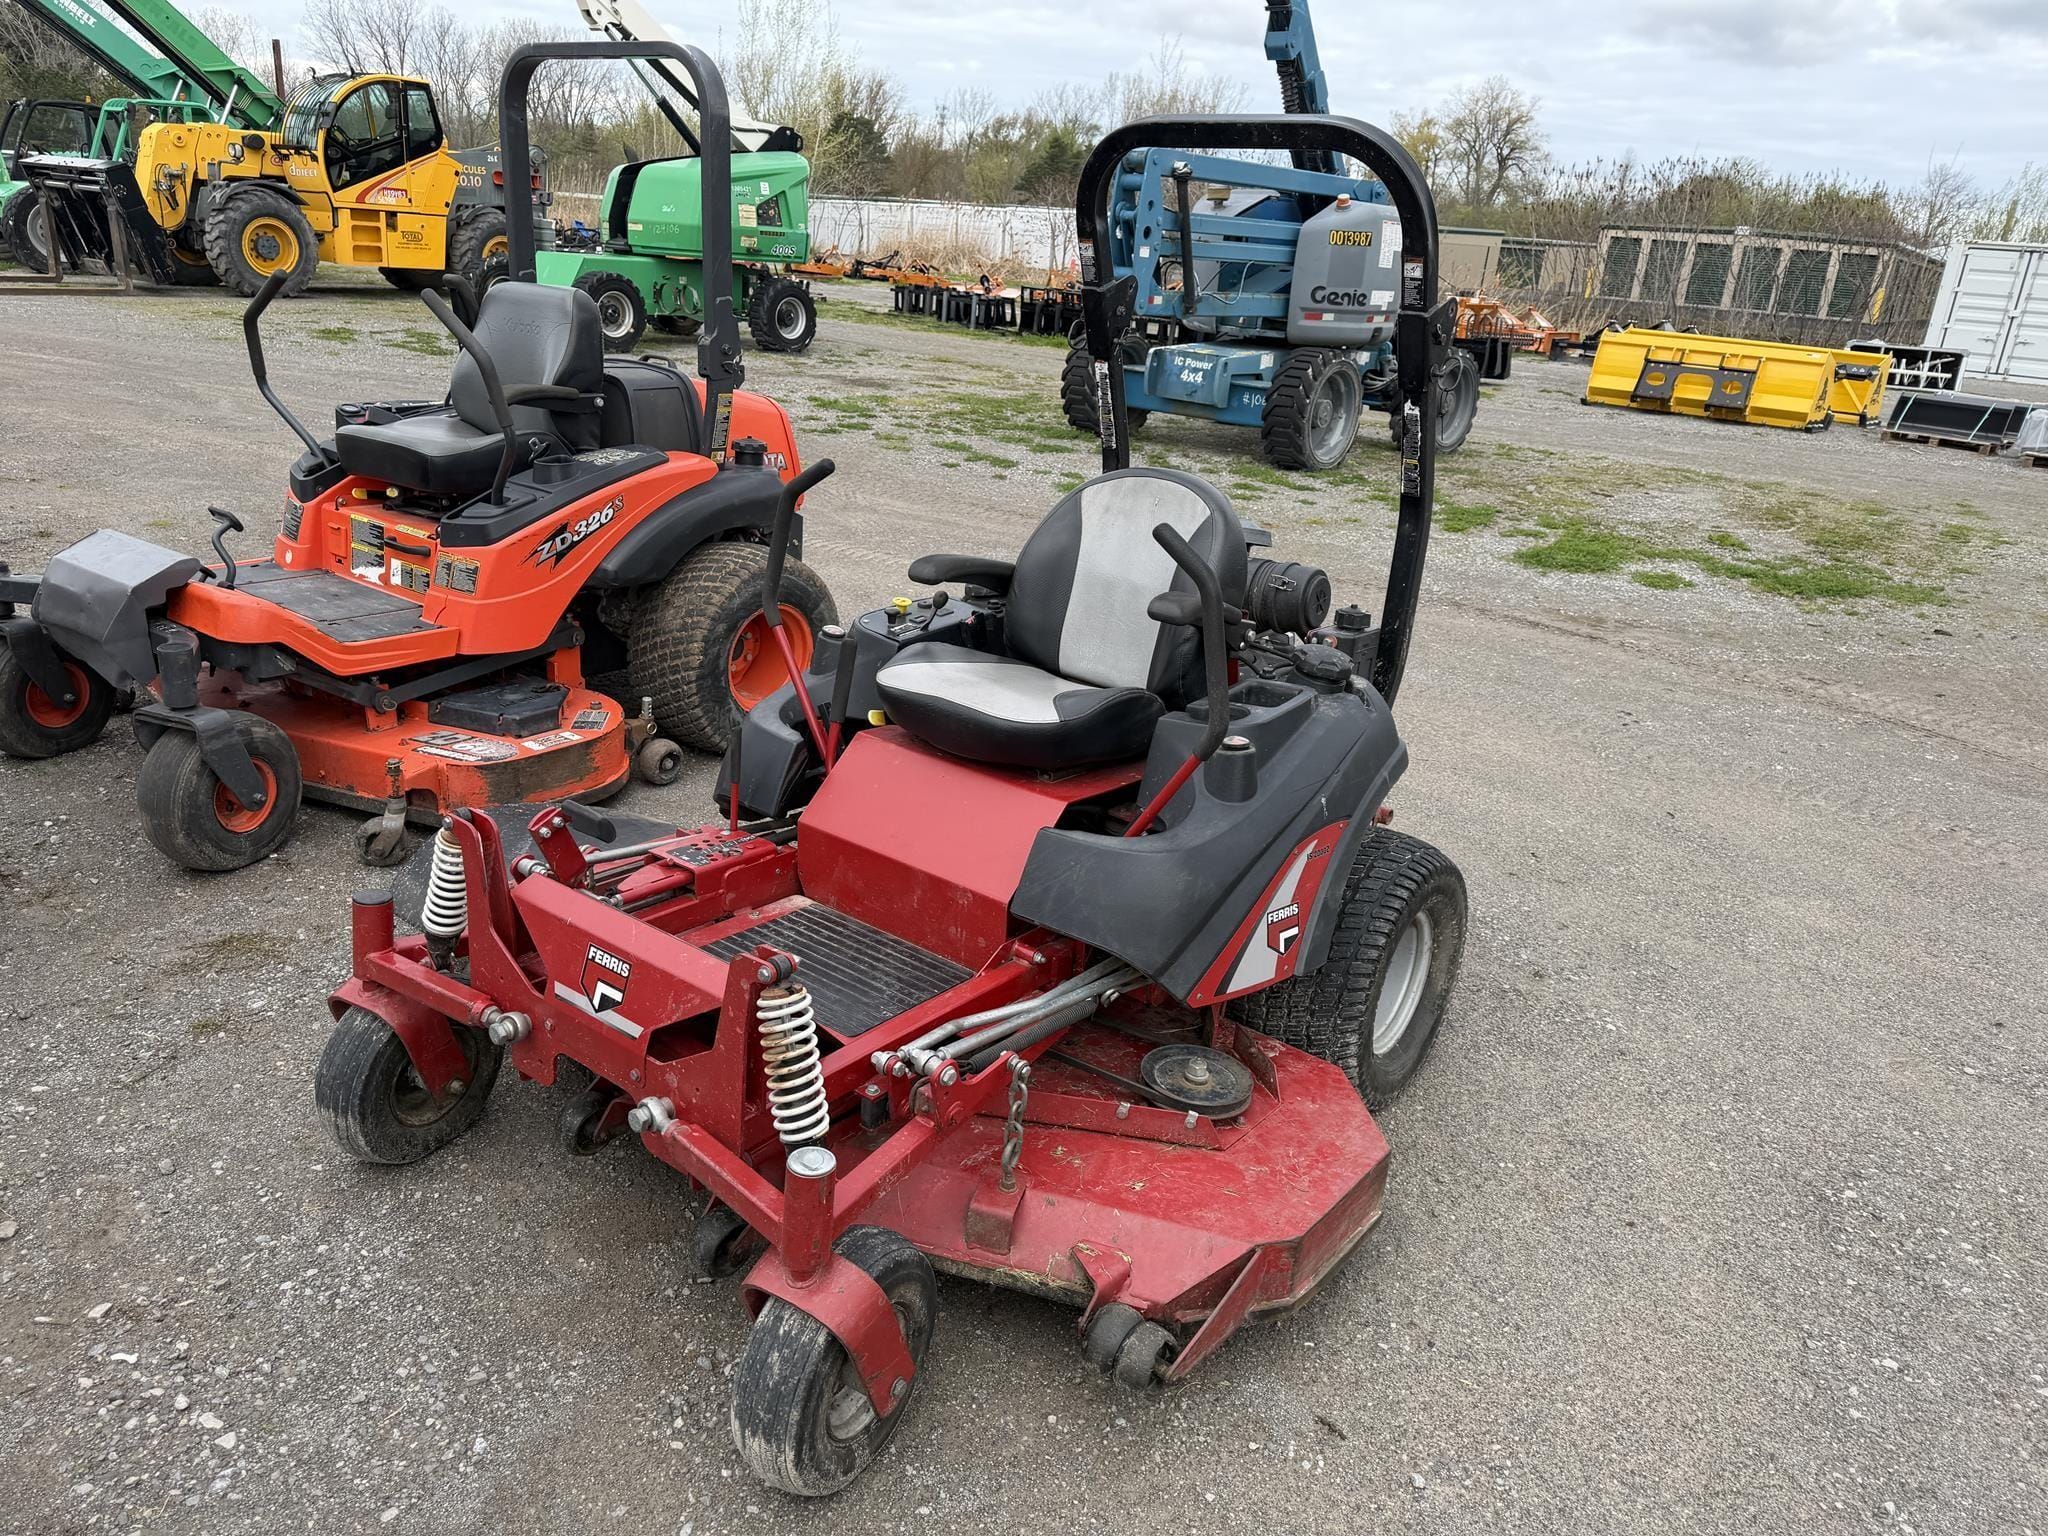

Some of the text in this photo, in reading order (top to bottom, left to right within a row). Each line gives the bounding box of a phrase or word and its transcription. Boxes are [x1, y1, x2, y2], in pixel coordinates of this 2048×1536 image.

[460, 164, 487, 175] CULES
[457, 175, 482, 188] 0.10
[400, 230, 422, 242] TOTAL
[1329, 229, 1373, 247] 0013987
[770, 244, 797, 256] 400S
[1310, 285, 1368, 308] Genie
[1174, 356, 1214, 370] IC Power
[1179, 368, 1204, 384] 4x4
[1267, 903, 1299, 925] FERRIS
[587, 945, 631, 978] FERRIS
